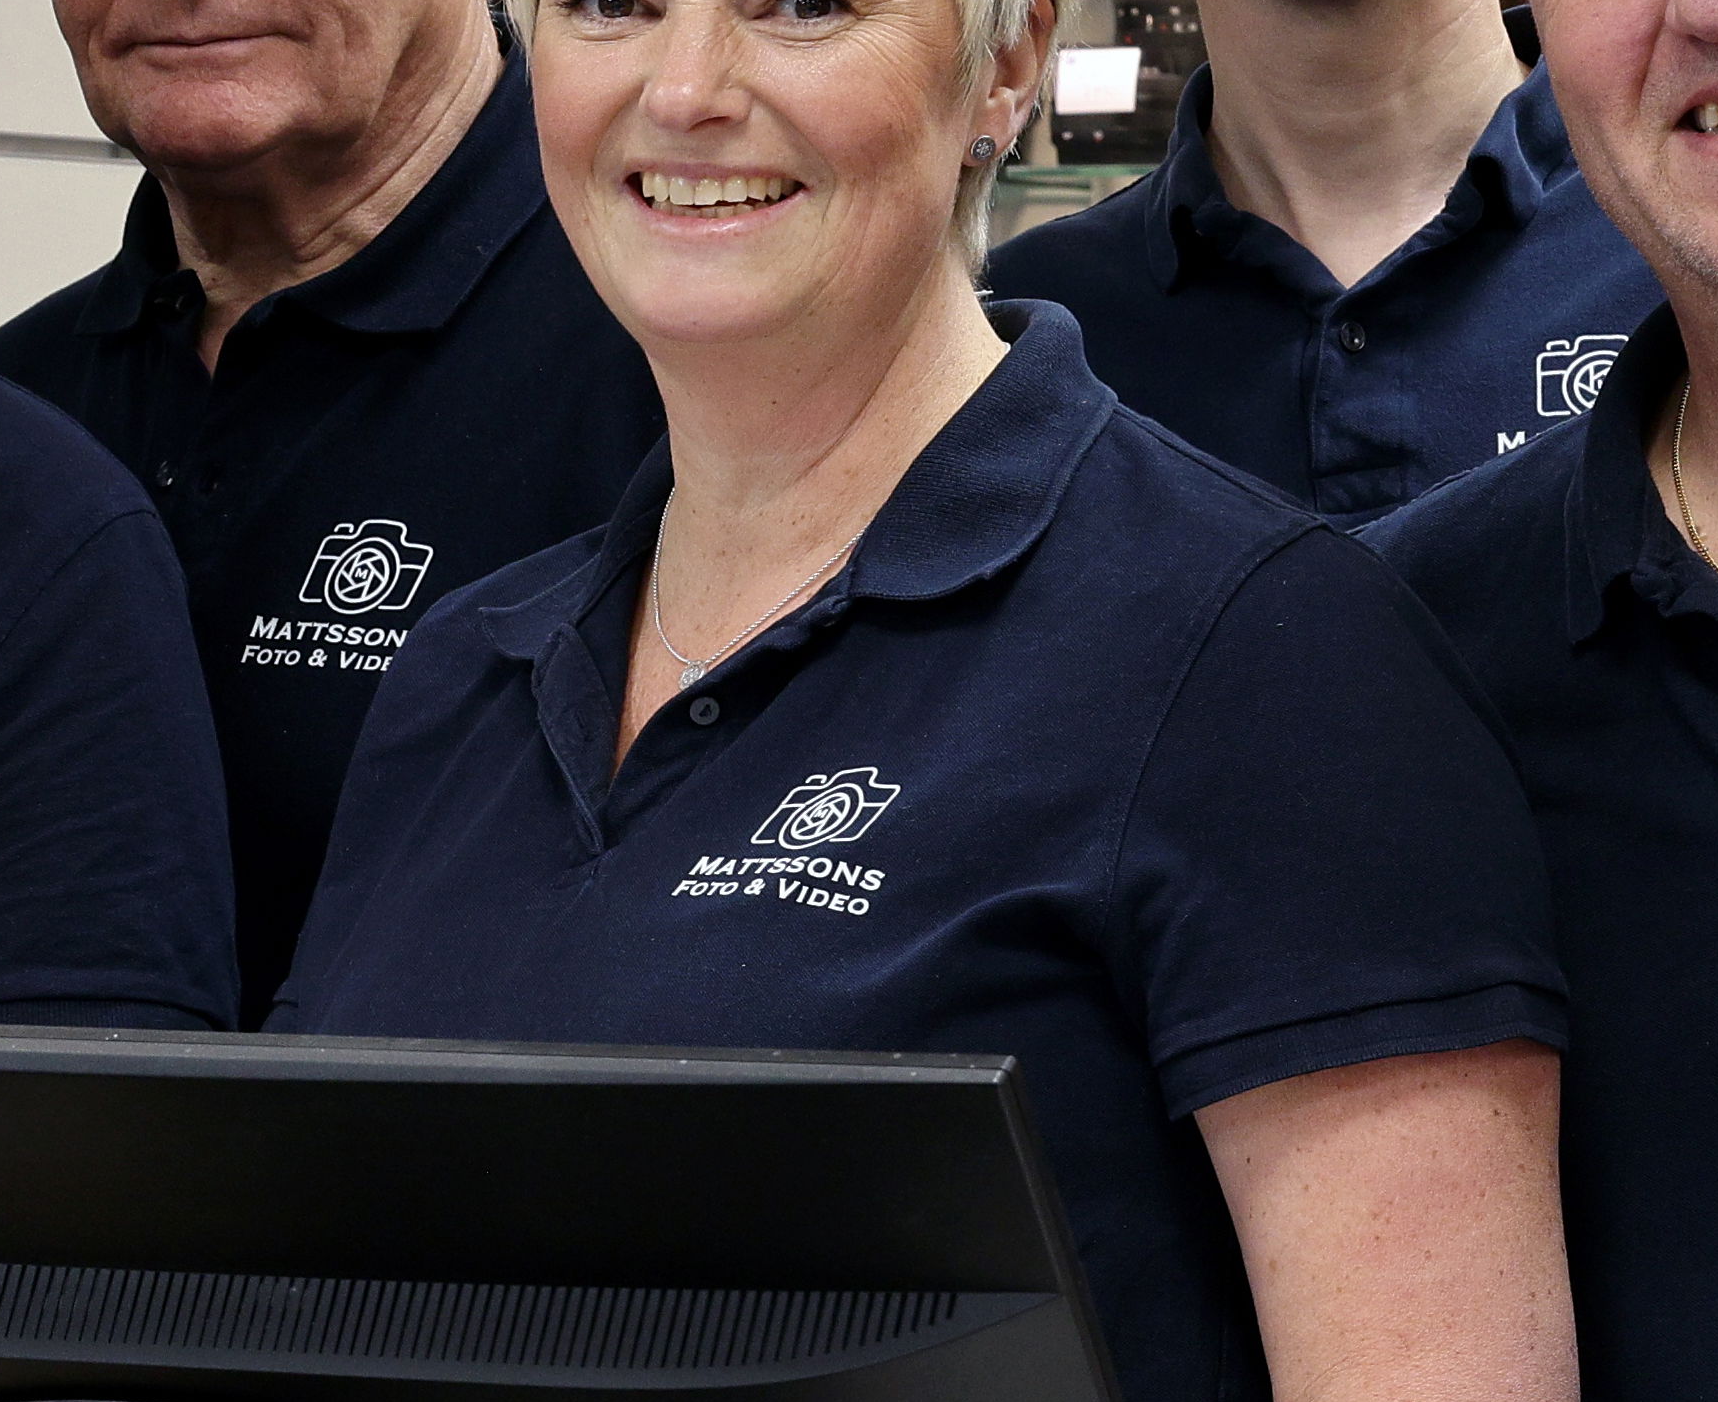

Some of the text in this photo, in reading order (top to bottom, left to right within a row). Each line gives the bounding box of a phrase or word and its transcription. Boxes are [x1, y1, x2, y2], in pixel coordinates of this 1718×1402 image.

[249, 615, 409, 648] MATTSSON
[241, 645, 394, 672] FOTO & VIDE
[688, 855, 886, 891] MATTSSONS
[671, 877, 870, 916] FOTO & VIDEO
